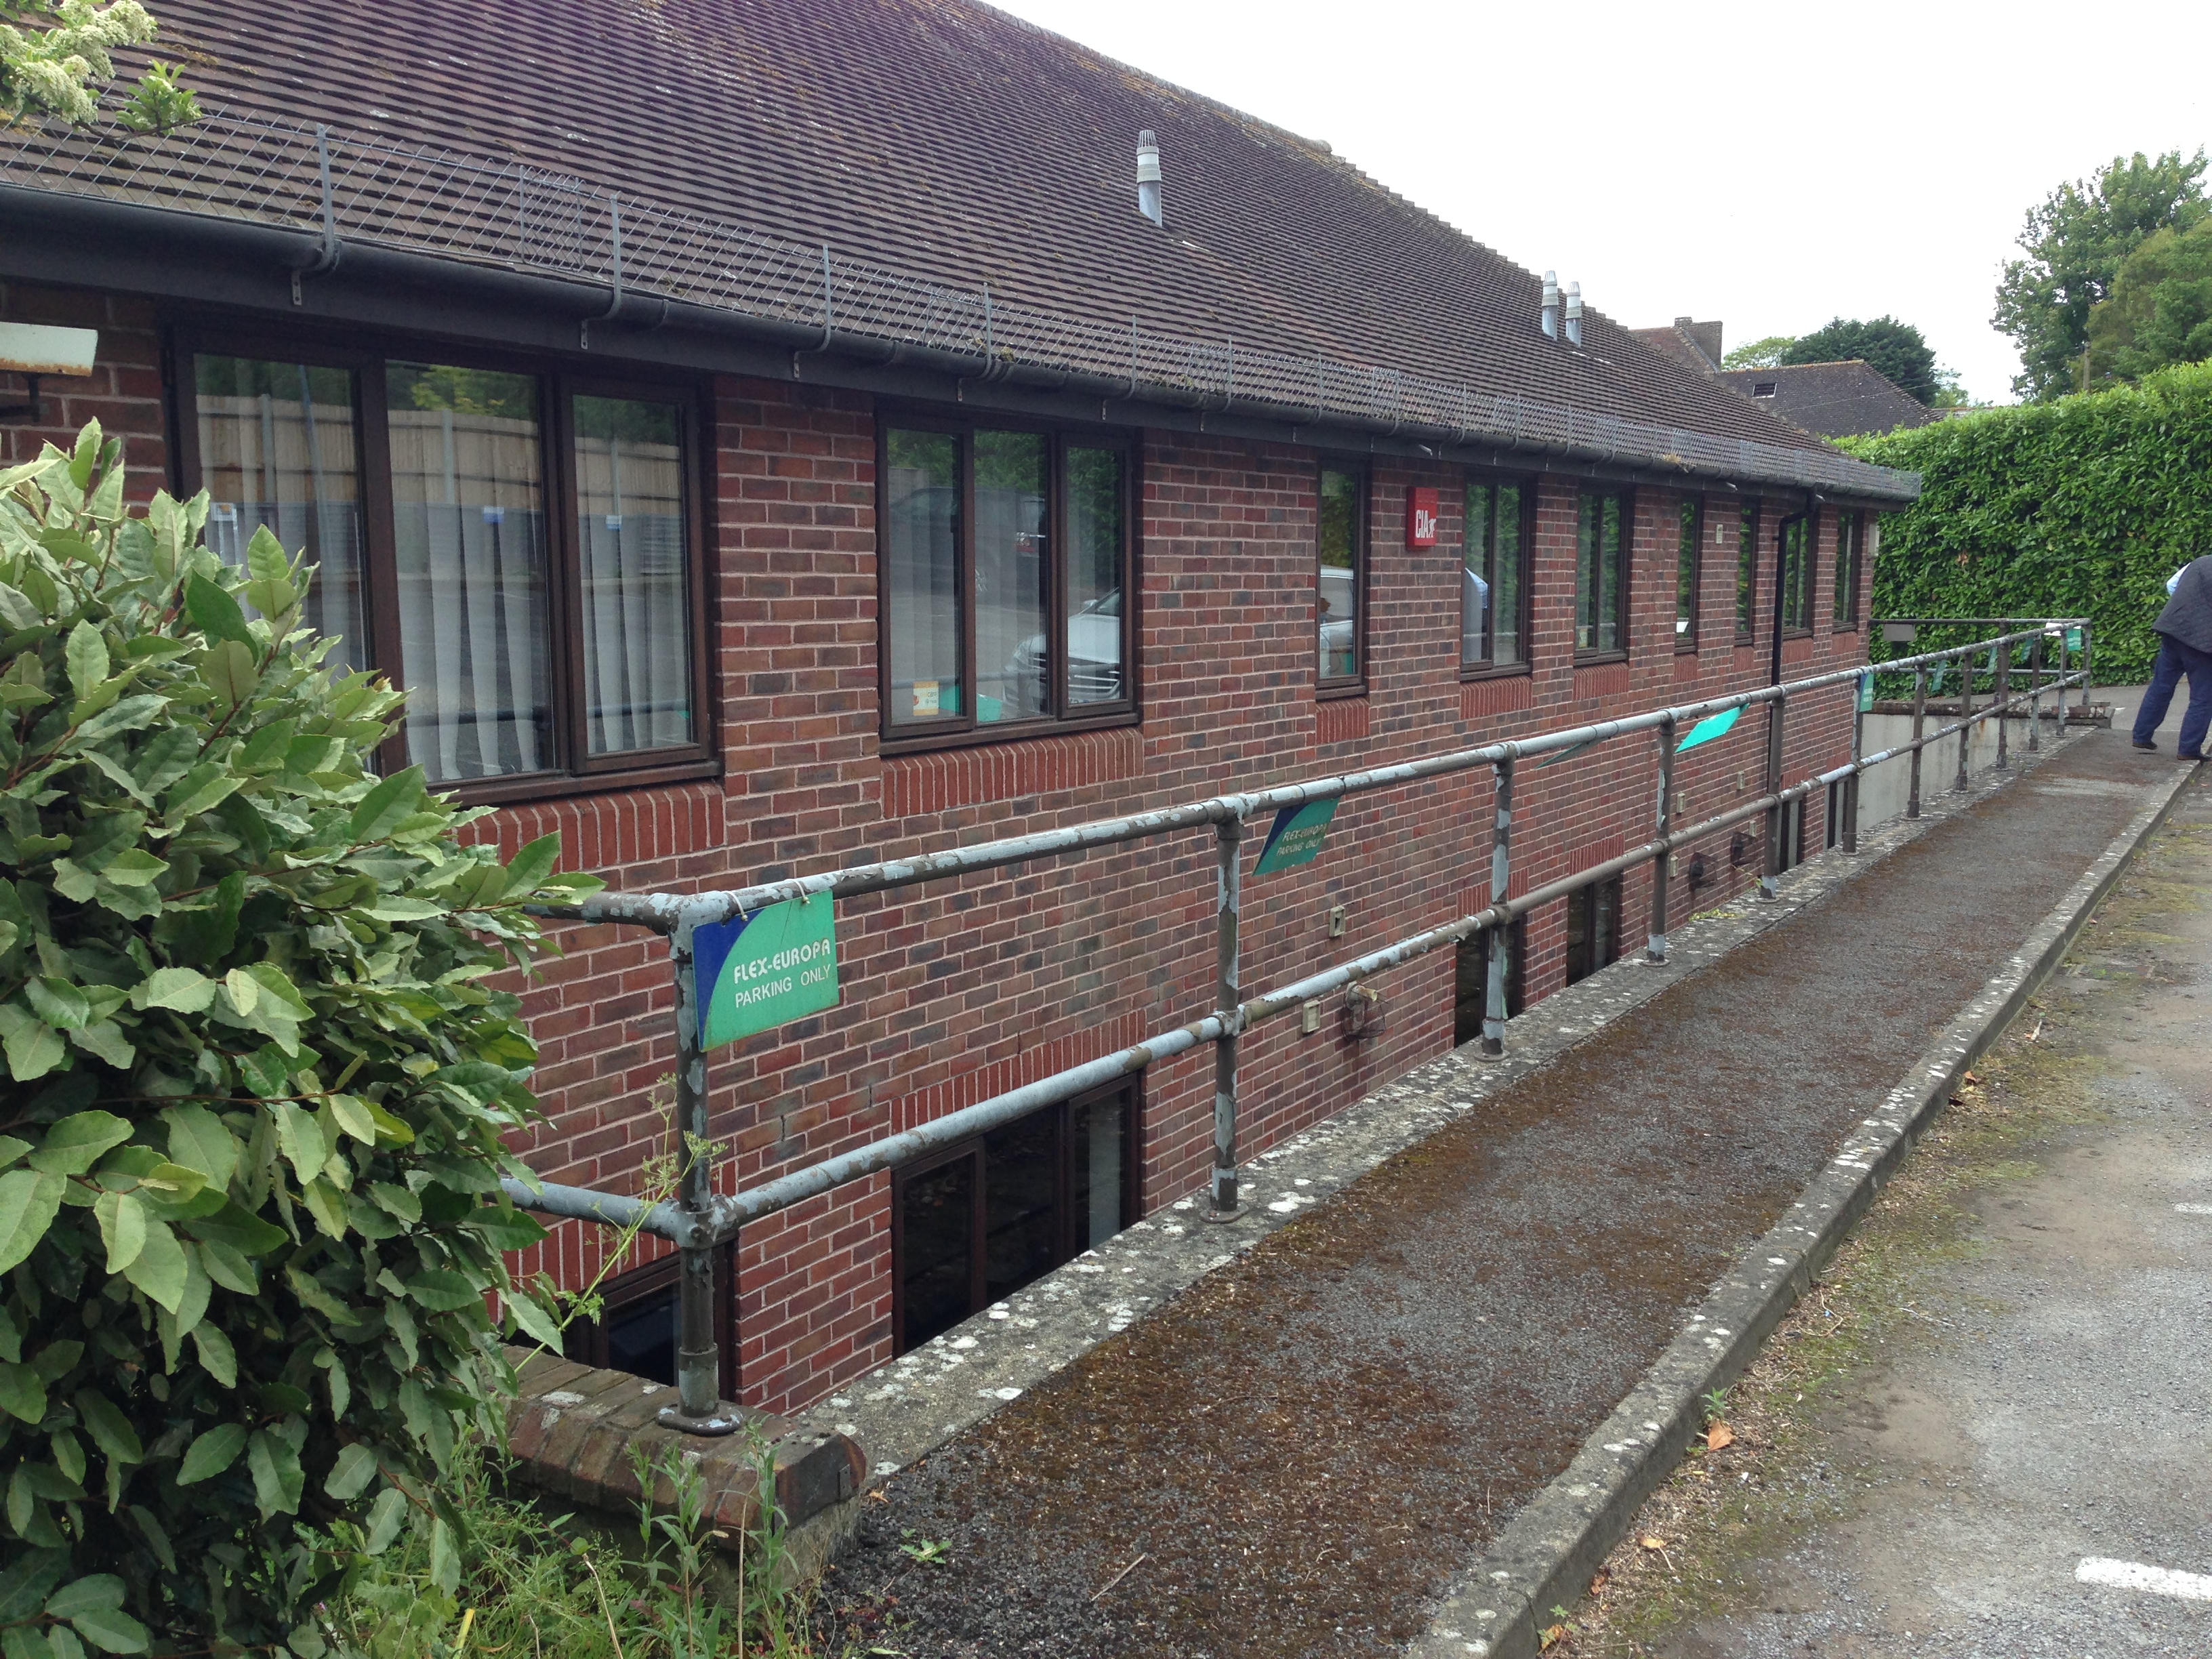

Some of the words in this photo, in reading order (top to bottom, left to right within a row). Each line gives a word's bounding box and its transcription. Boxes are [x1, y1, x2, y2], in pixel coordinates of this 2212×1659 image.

[1415, 510, 1429, 539] CIA
[1276, 842, 1305, 856] PARKING
[1305, 838, 1322, 849] ONLY
[734, 939, 831, 984] FLEX-EUROPA
[735, 977, 792, 1008] PARKING
[800, 964, 831, 986] ONLY
